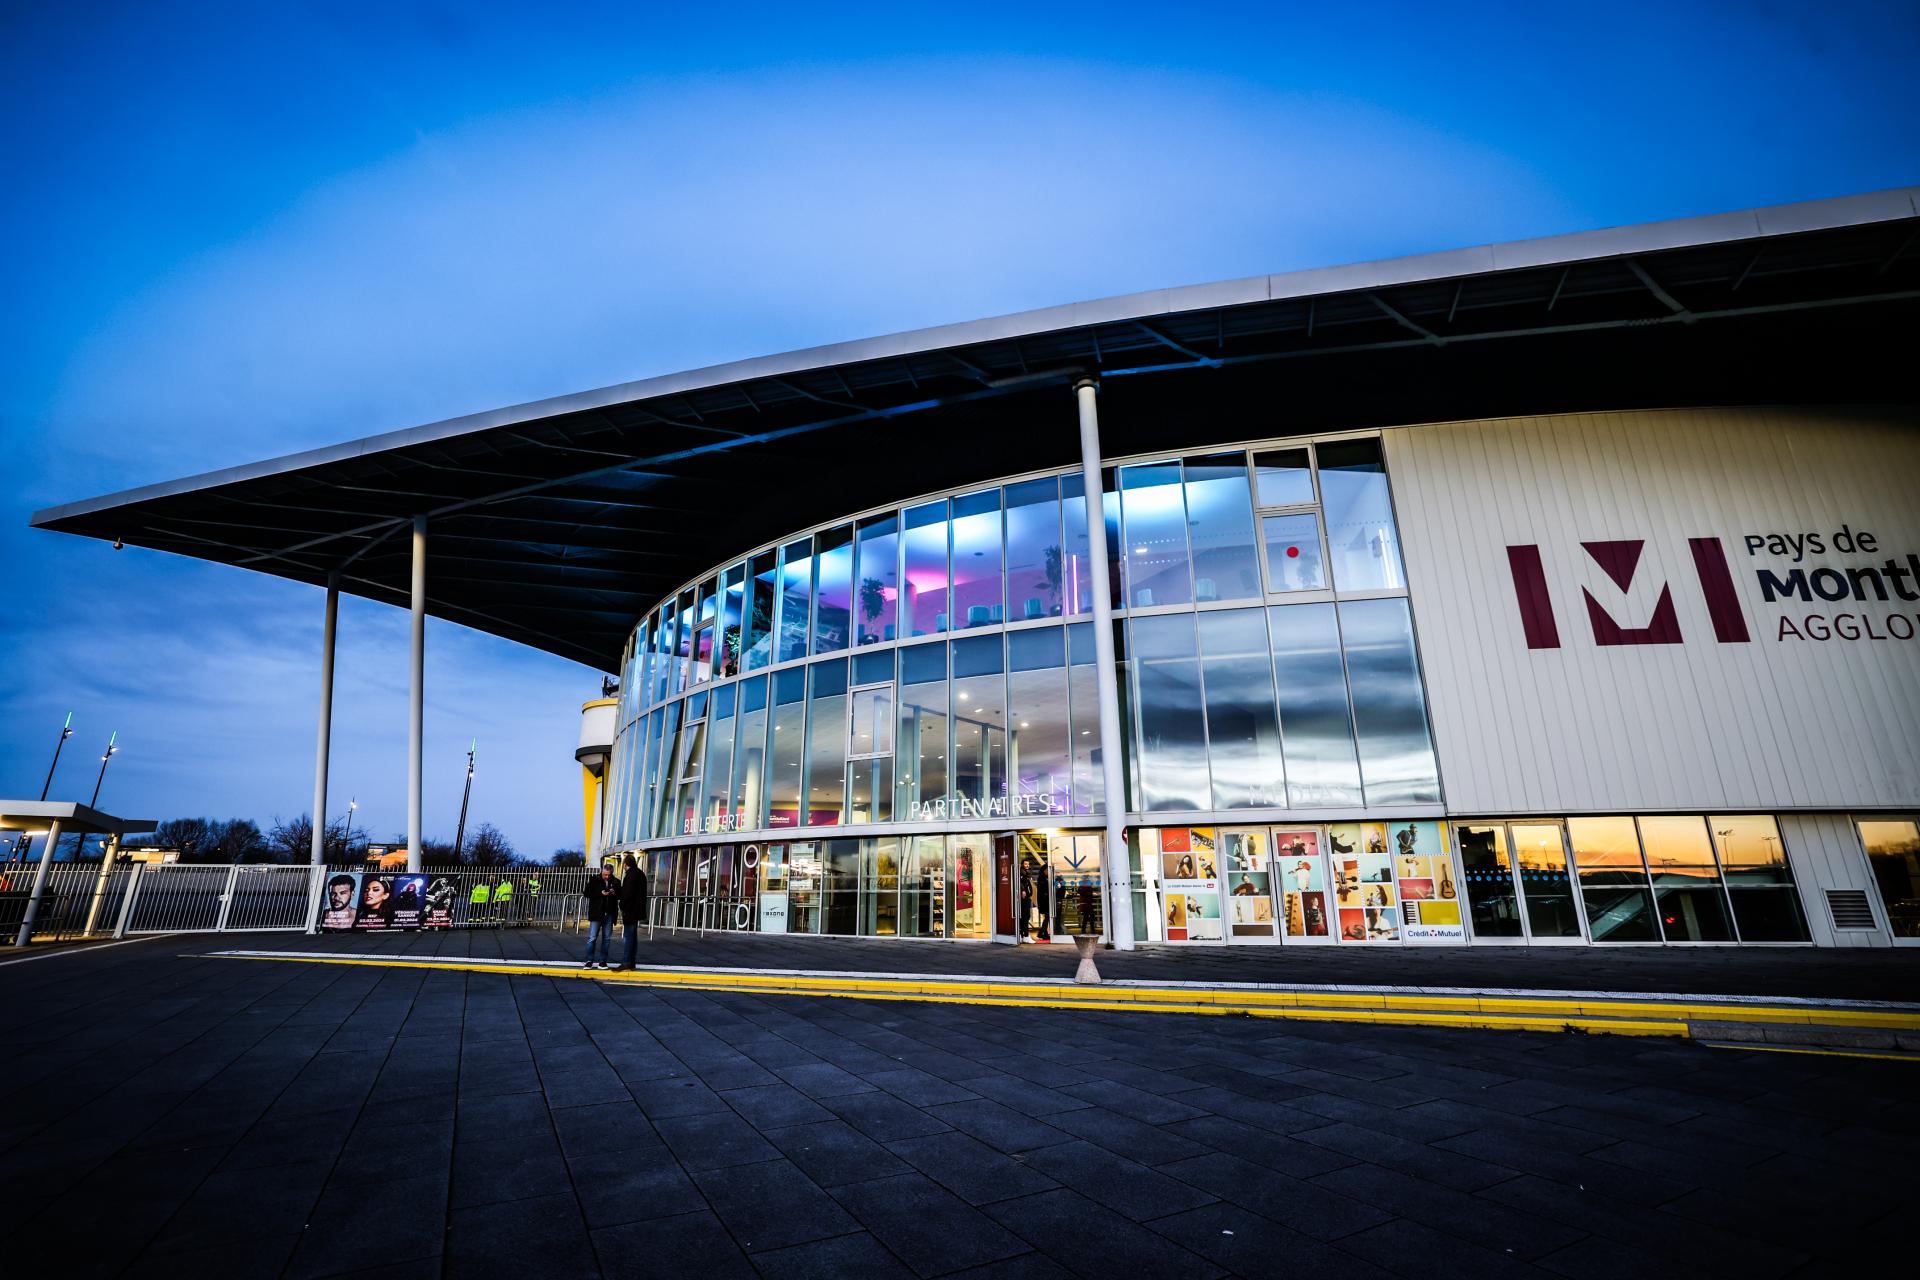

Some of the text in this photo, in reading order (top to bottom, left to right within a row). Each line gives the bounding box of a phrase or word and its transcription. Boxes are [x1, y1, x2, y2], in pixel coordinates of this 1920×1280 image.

[1744, 524, 1879, 562] Pays de
[1779, 613, 1920, 641] AGGLO
[911, 793, 1050, 818] PARTENAIRES
[684, 813, 748, 833] BILLETTERIE
